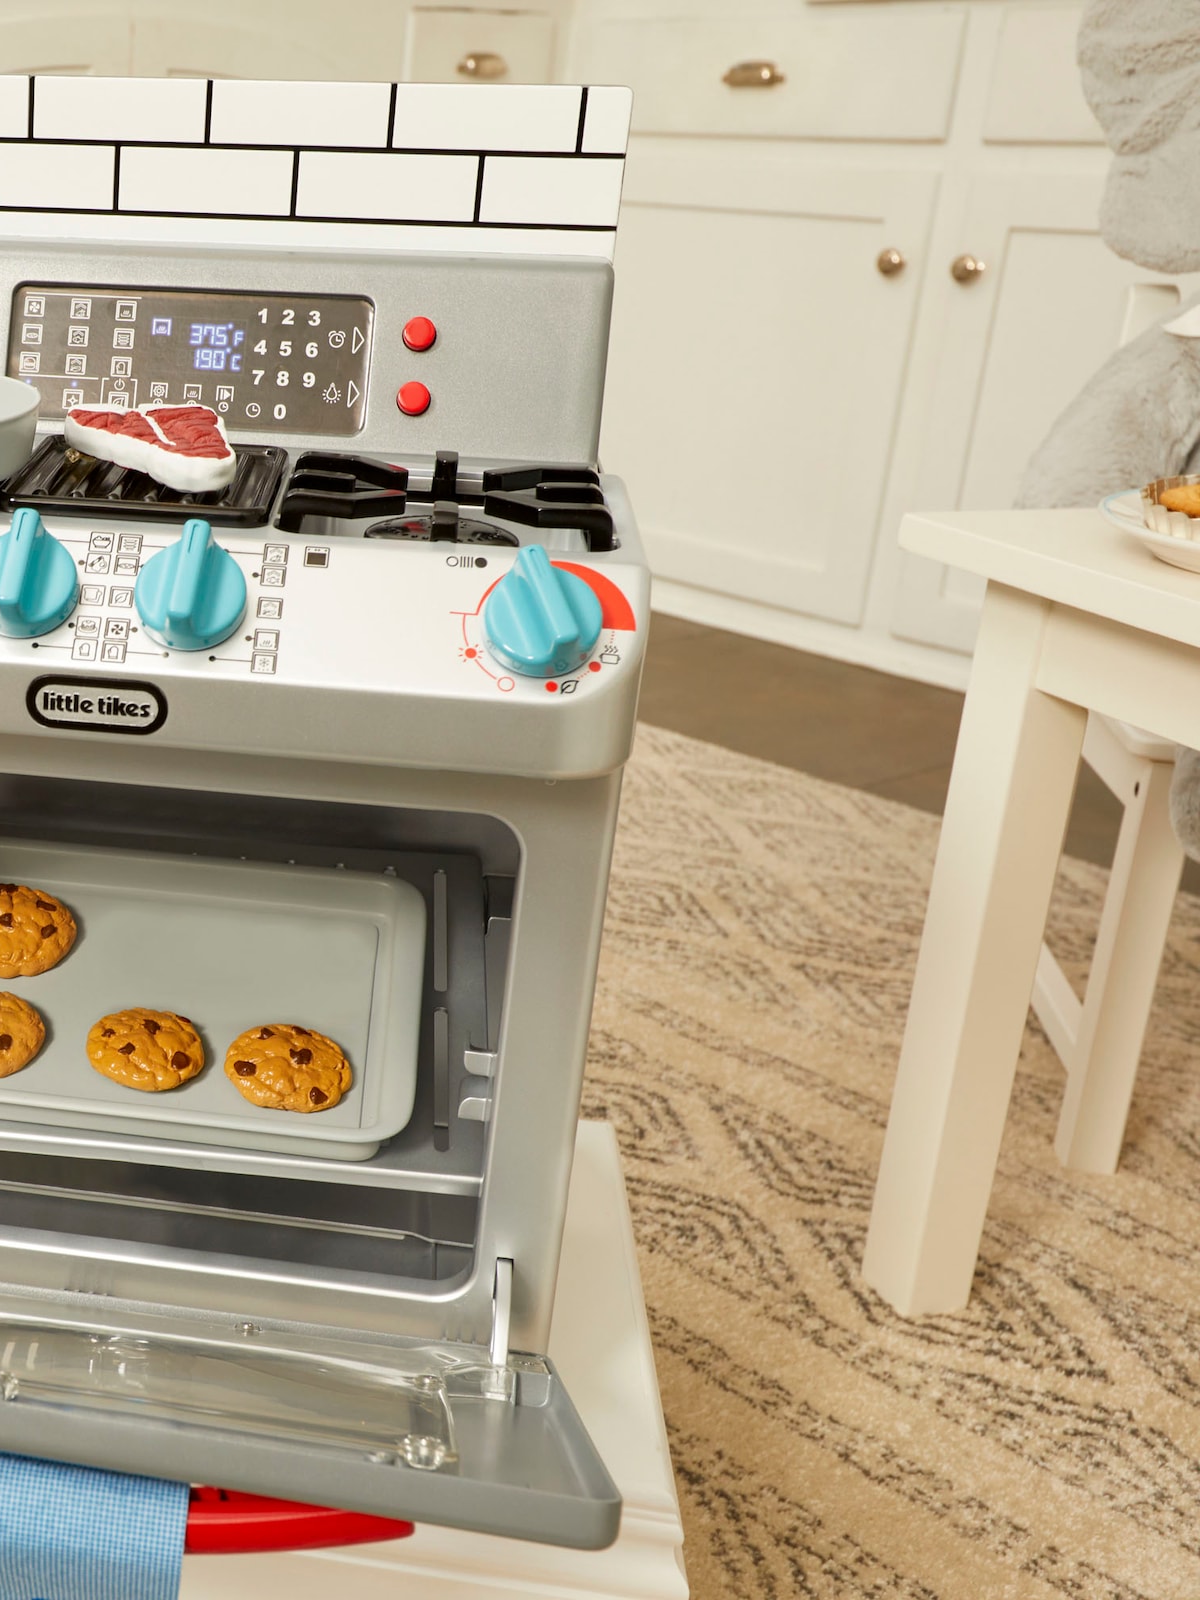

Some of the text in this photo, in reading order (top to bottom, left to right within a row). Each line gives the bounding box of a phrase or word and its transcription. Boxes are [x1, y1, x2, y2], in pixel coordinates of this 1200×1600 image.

[258, 308, 321, 326] 1 2 3
[253, 339, 319, 358] 4 5 6
[252, 369, 316, 388] 7 8 9
[273, 404, 287, 420] 0
[43, 692, 151, 717] little tikes
